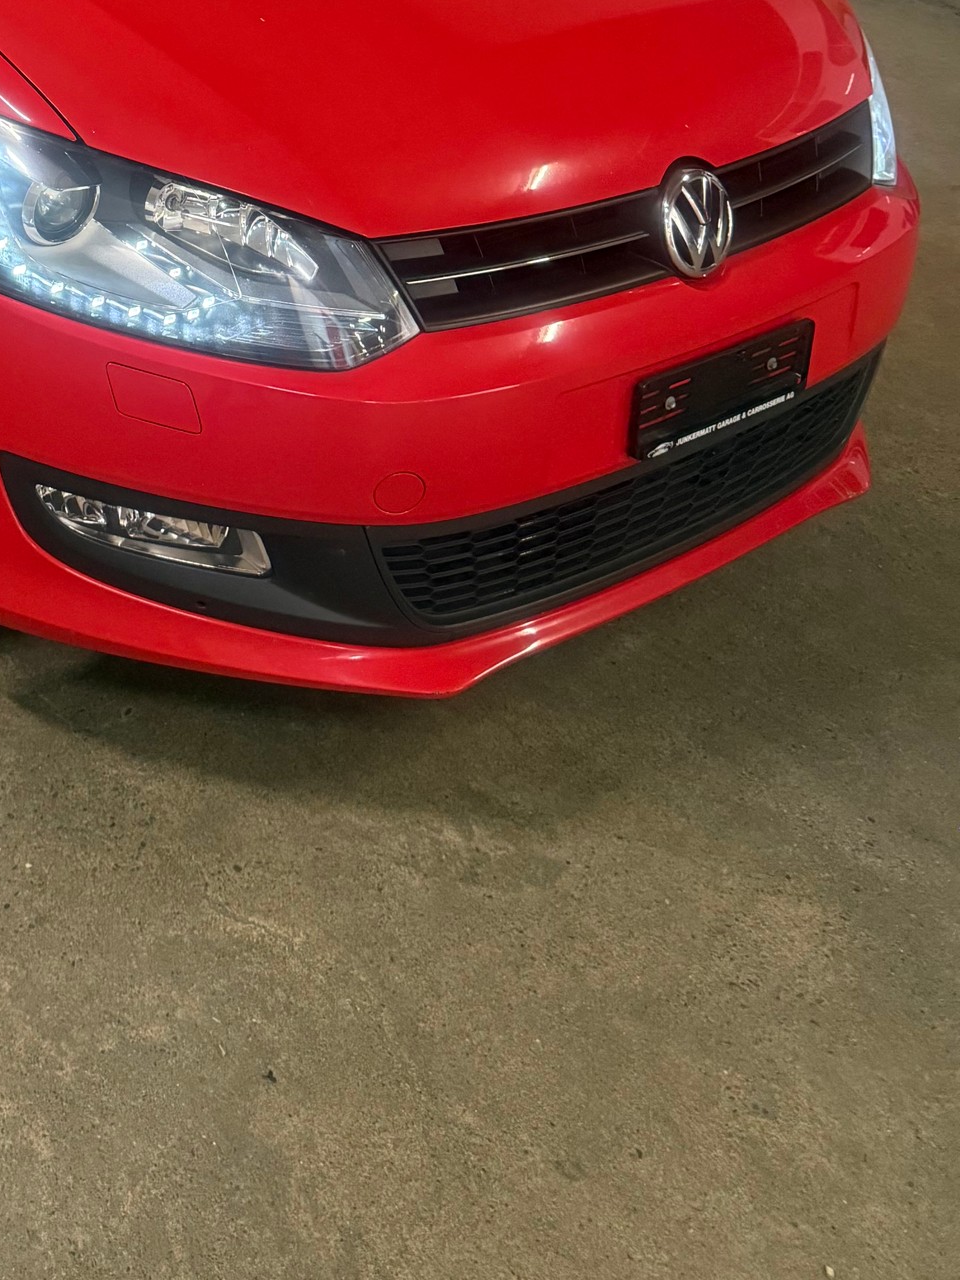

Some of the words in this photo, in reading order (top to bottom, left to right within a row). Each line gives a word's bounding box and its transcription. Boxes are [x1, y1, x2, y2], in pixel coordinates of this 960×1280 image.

[676, 425, 717, 446] JUNKERMATT
[716, 413, 741, 430] GARAGE
[746, 394, 786, 417] CARROSSERIE
